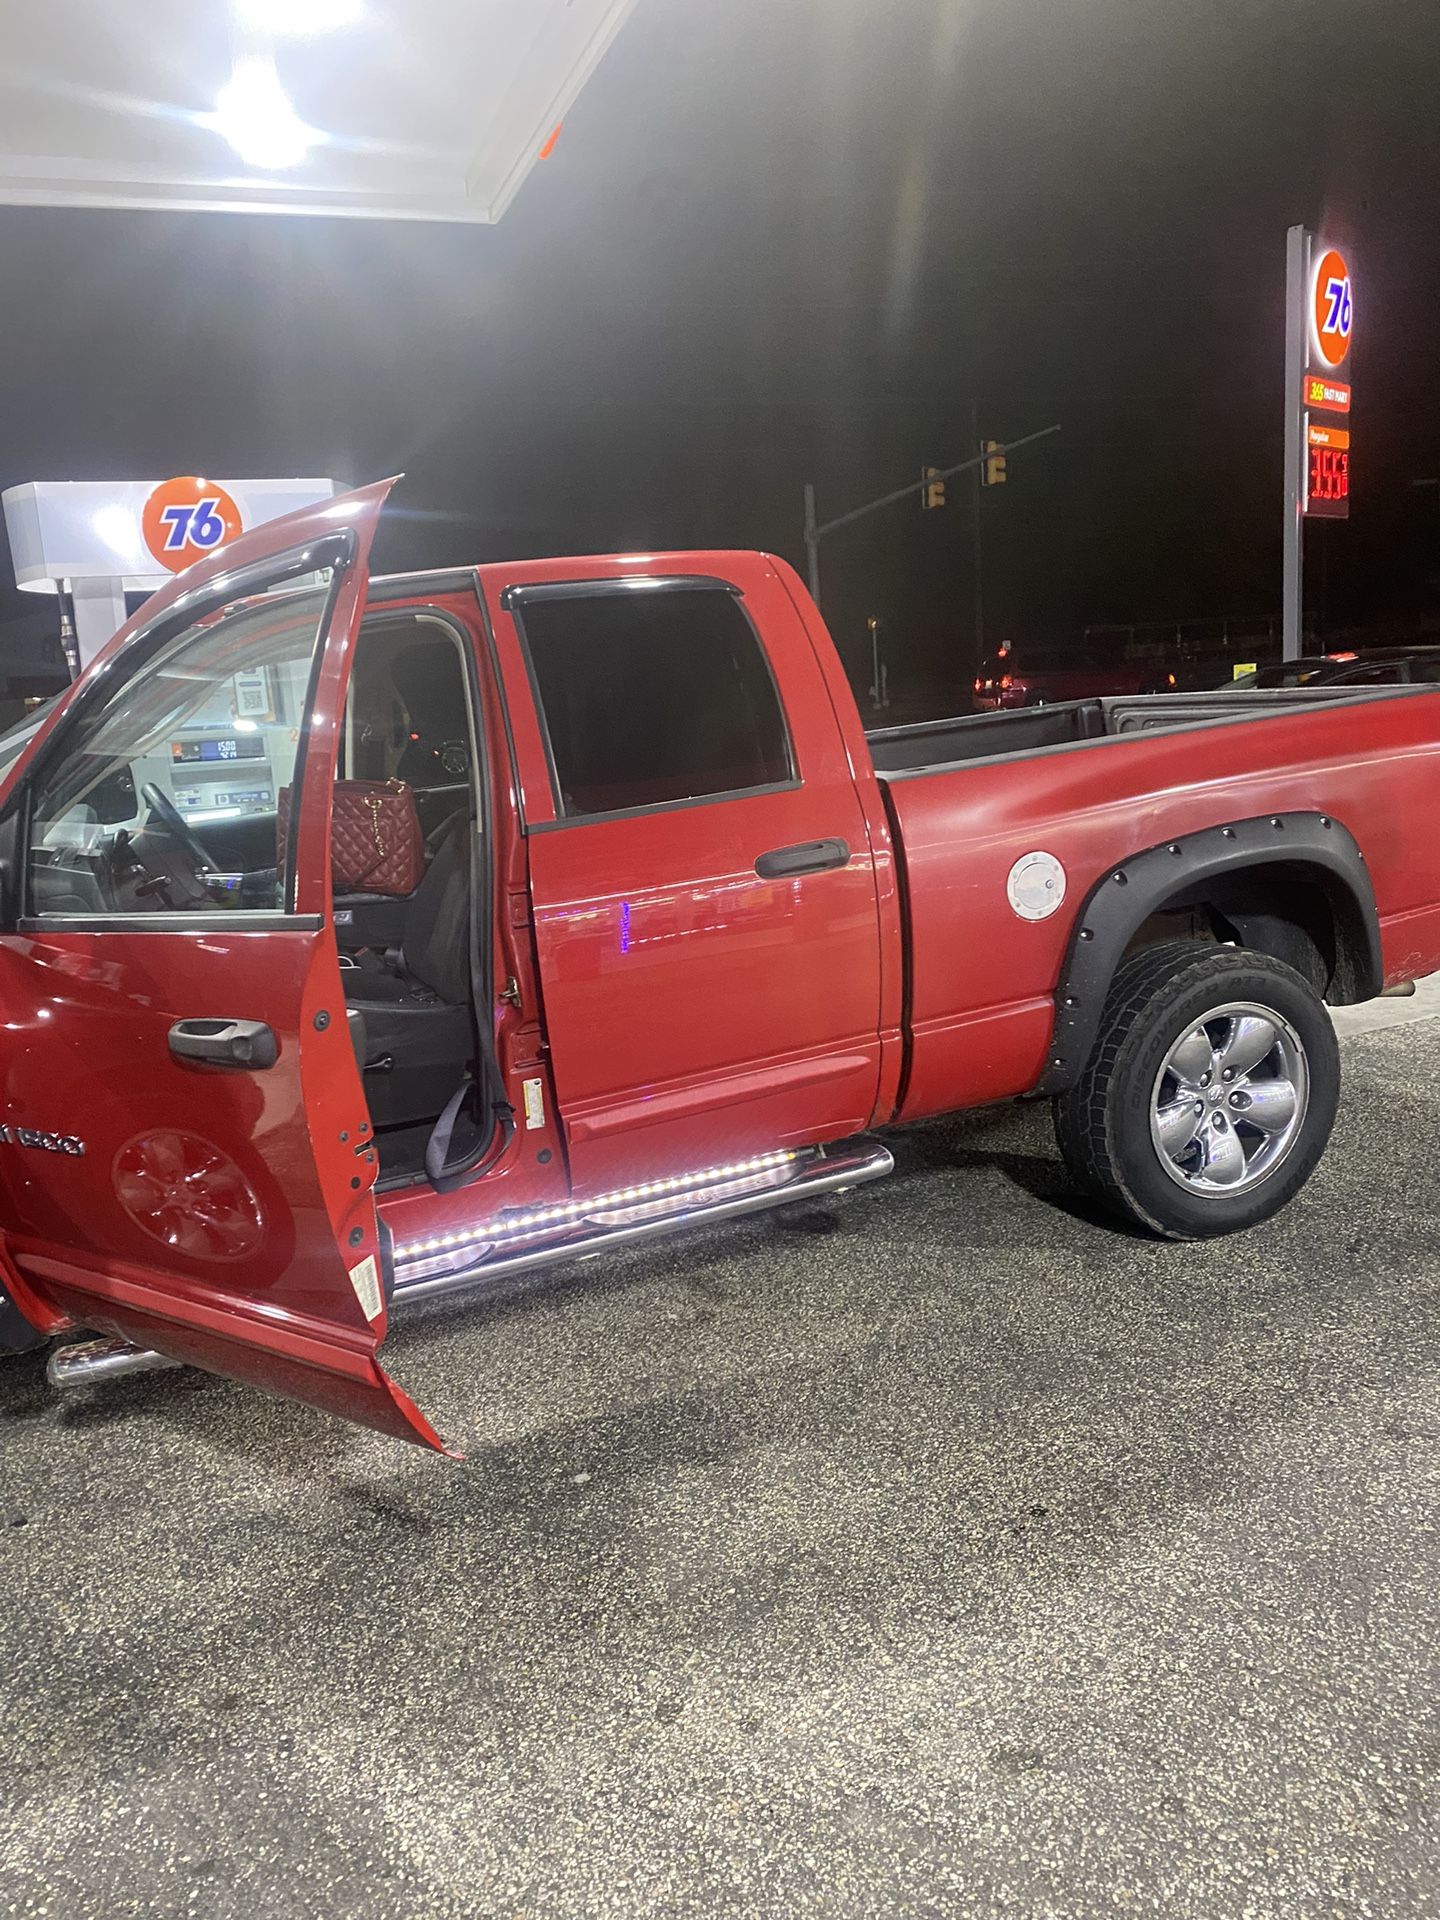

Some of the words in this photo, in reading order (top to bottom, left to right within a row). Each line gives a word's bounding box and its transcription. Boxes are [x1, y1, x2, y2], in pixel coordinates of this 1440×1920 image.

[1322, 276, 1353, 338] 76
[1310, 382, 1325, 401] 365
[159, 498, 226, 551] 76
